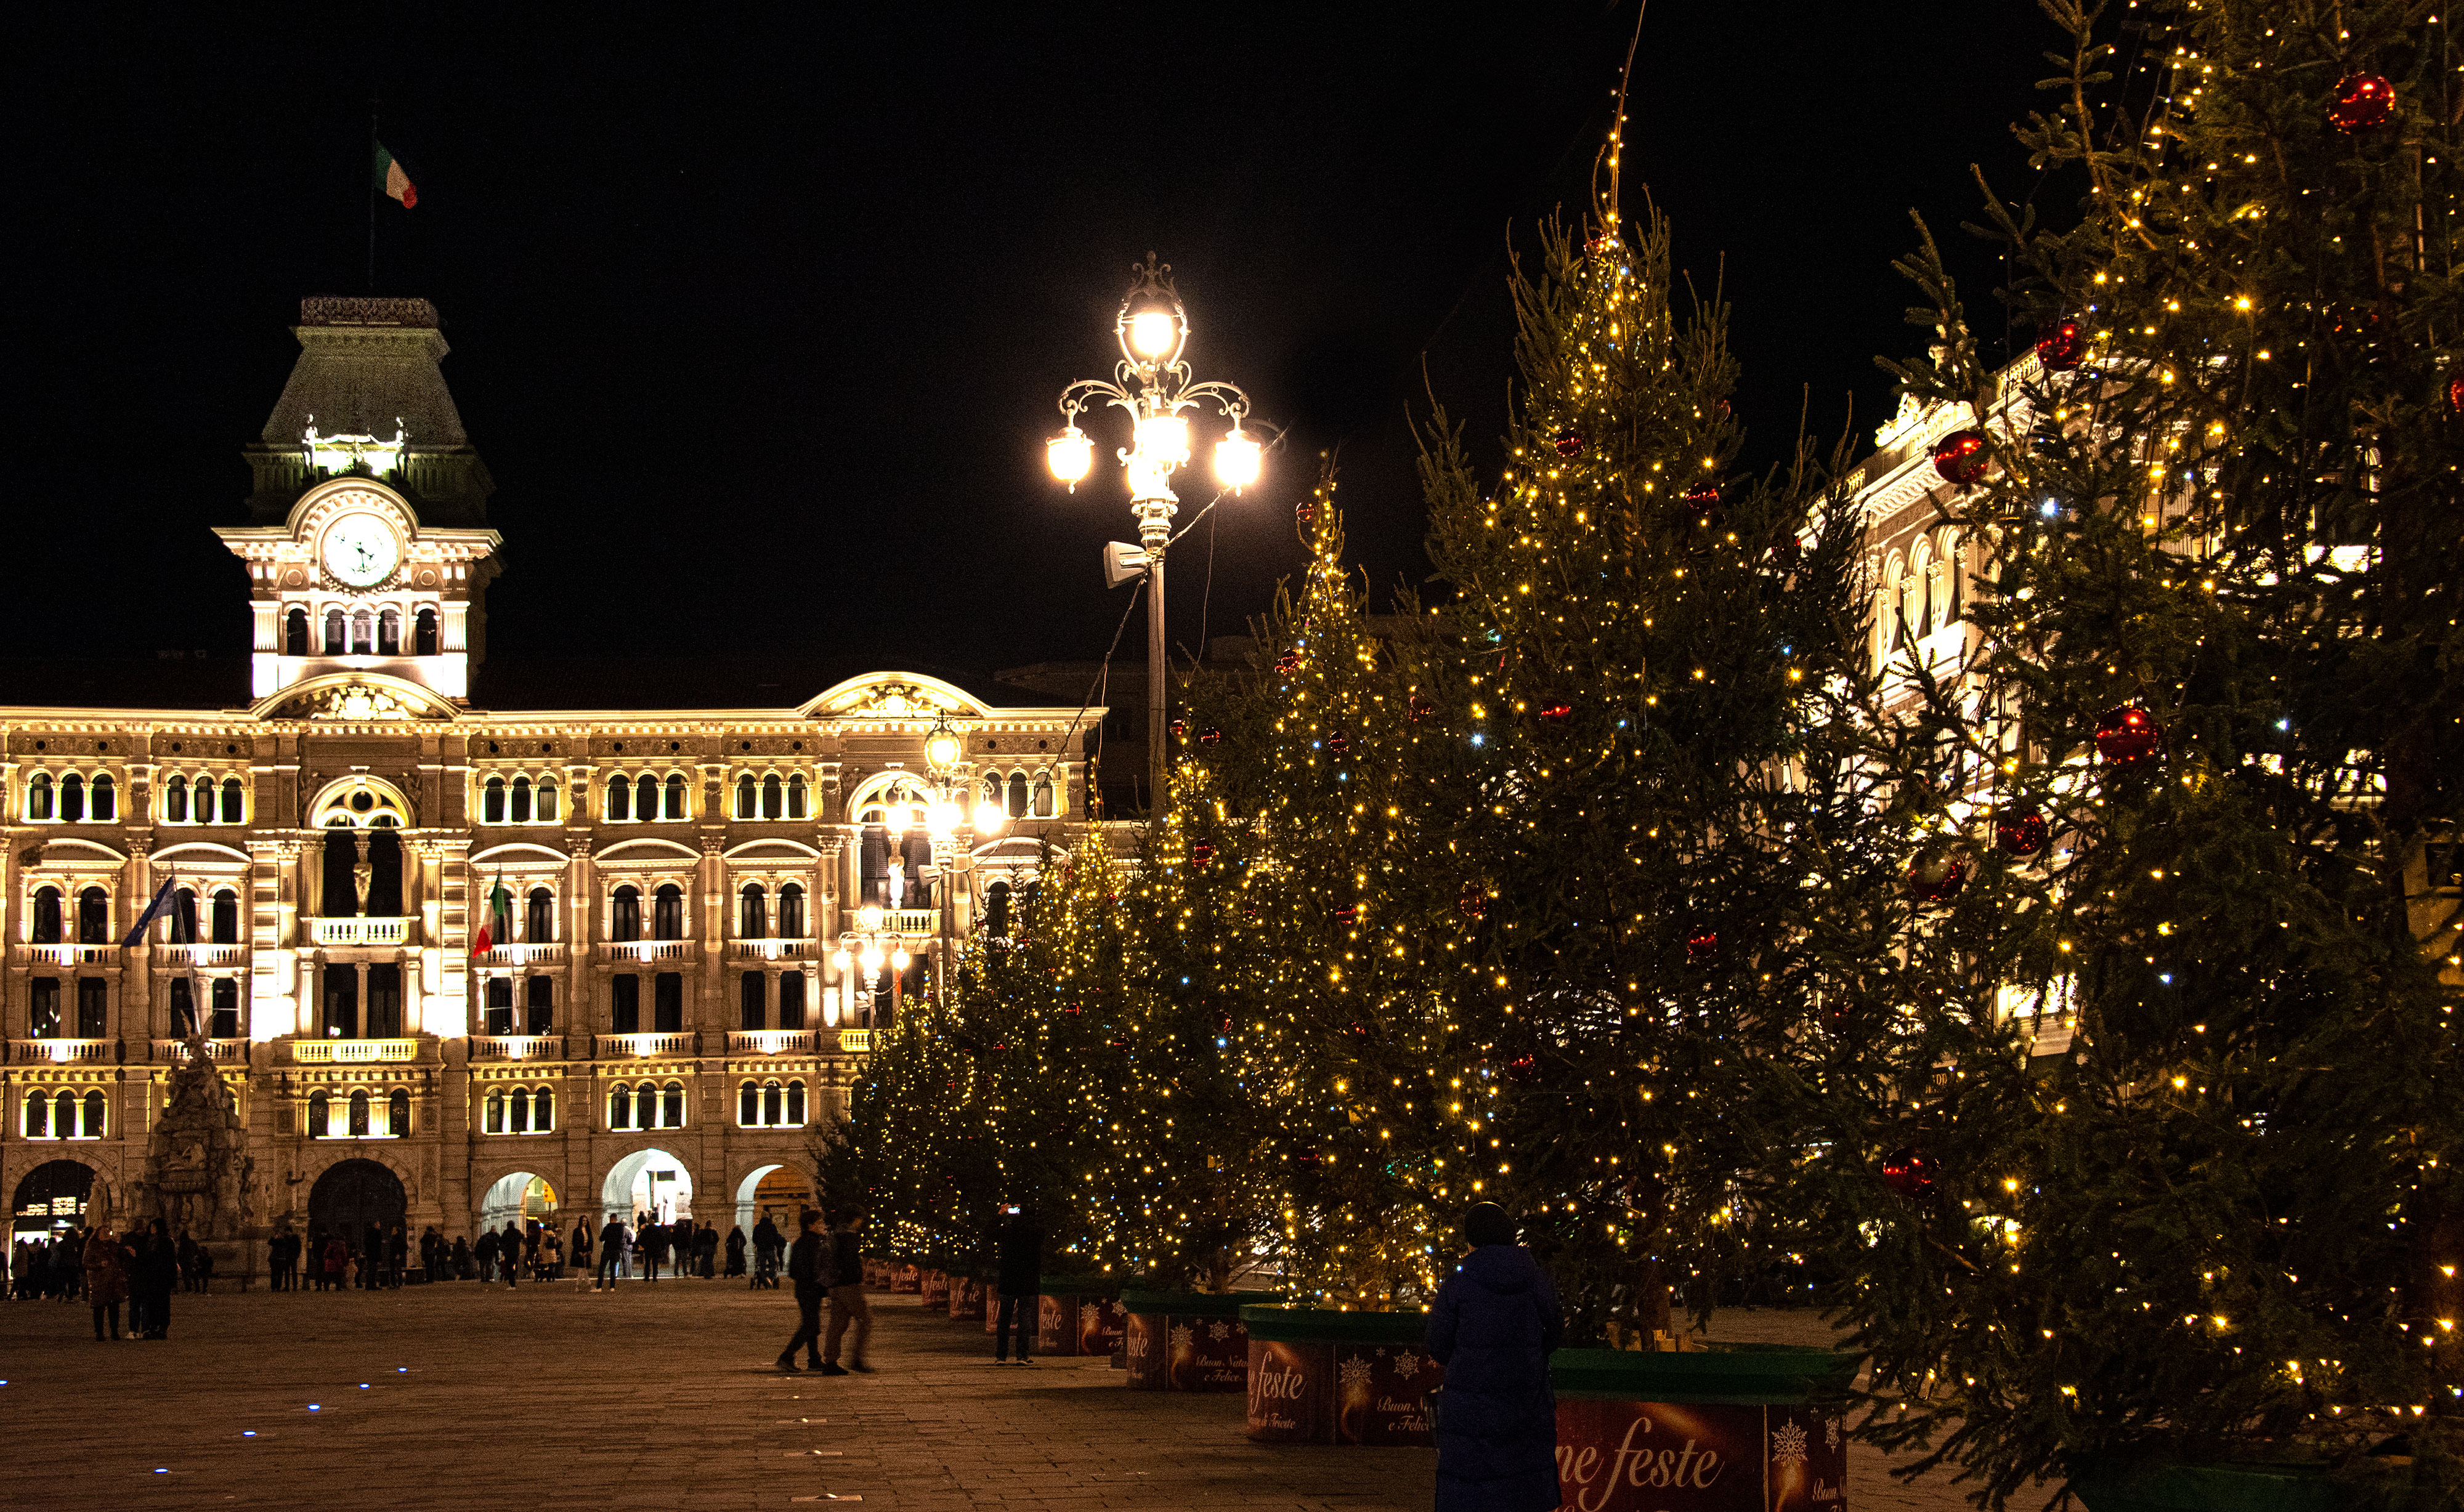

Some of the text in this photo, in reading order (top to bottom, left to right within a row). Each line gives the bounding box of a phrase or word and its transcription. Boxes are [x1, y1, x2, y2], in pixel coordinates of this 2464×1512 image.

[1196, 1354, 1222, 1367] Buon
[1250, 1351, 1307, 1415] feste
[1376, 1395, 1412, 1412] Buon
[1388, 1422, 1395, 1431] e
[1578, 1417, 1725, 1512] feste
[1812, 1478, 1838, 1502] Buon
